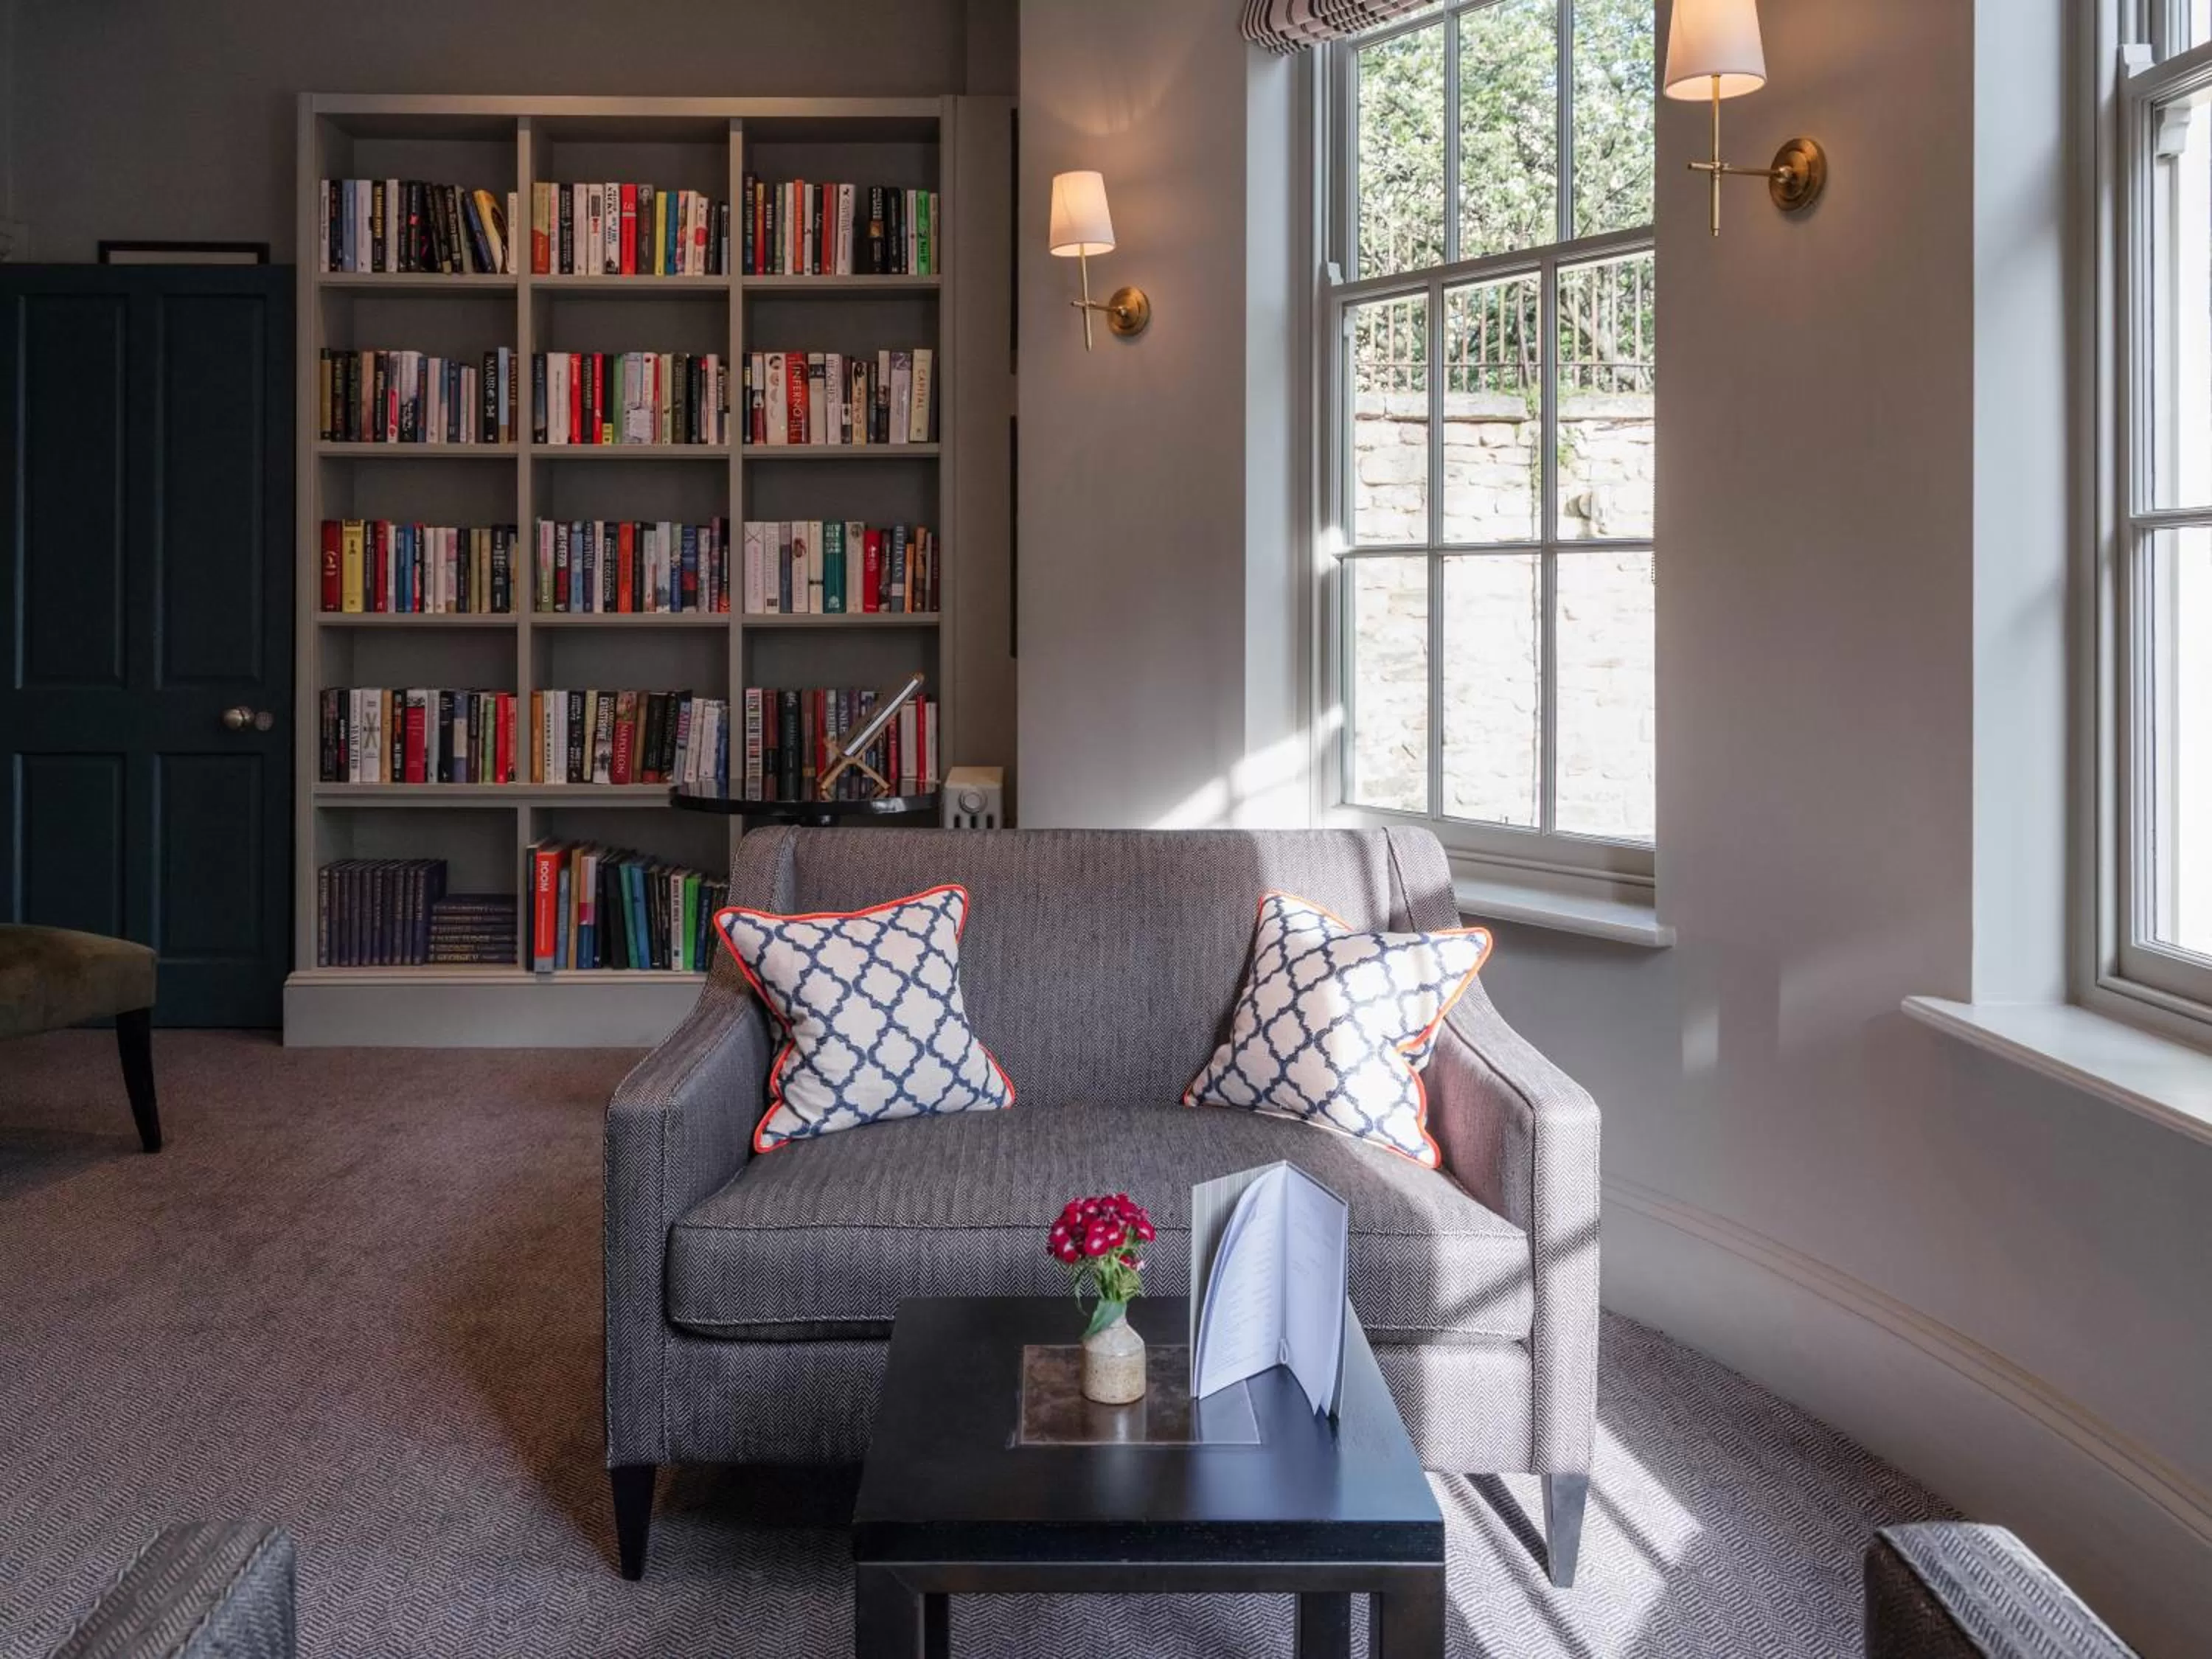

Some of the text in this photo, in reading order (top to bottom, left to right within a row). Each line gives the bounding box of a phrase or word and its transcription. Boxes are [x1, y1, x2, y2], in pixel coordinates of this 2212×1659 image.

[792, 366, 803, 417] INFERNO
[916, 368, 927, 411] CAPITAL
[616, 725, 629, 773] NAPOLEON
[539, 860, 549, 892] ROOM
